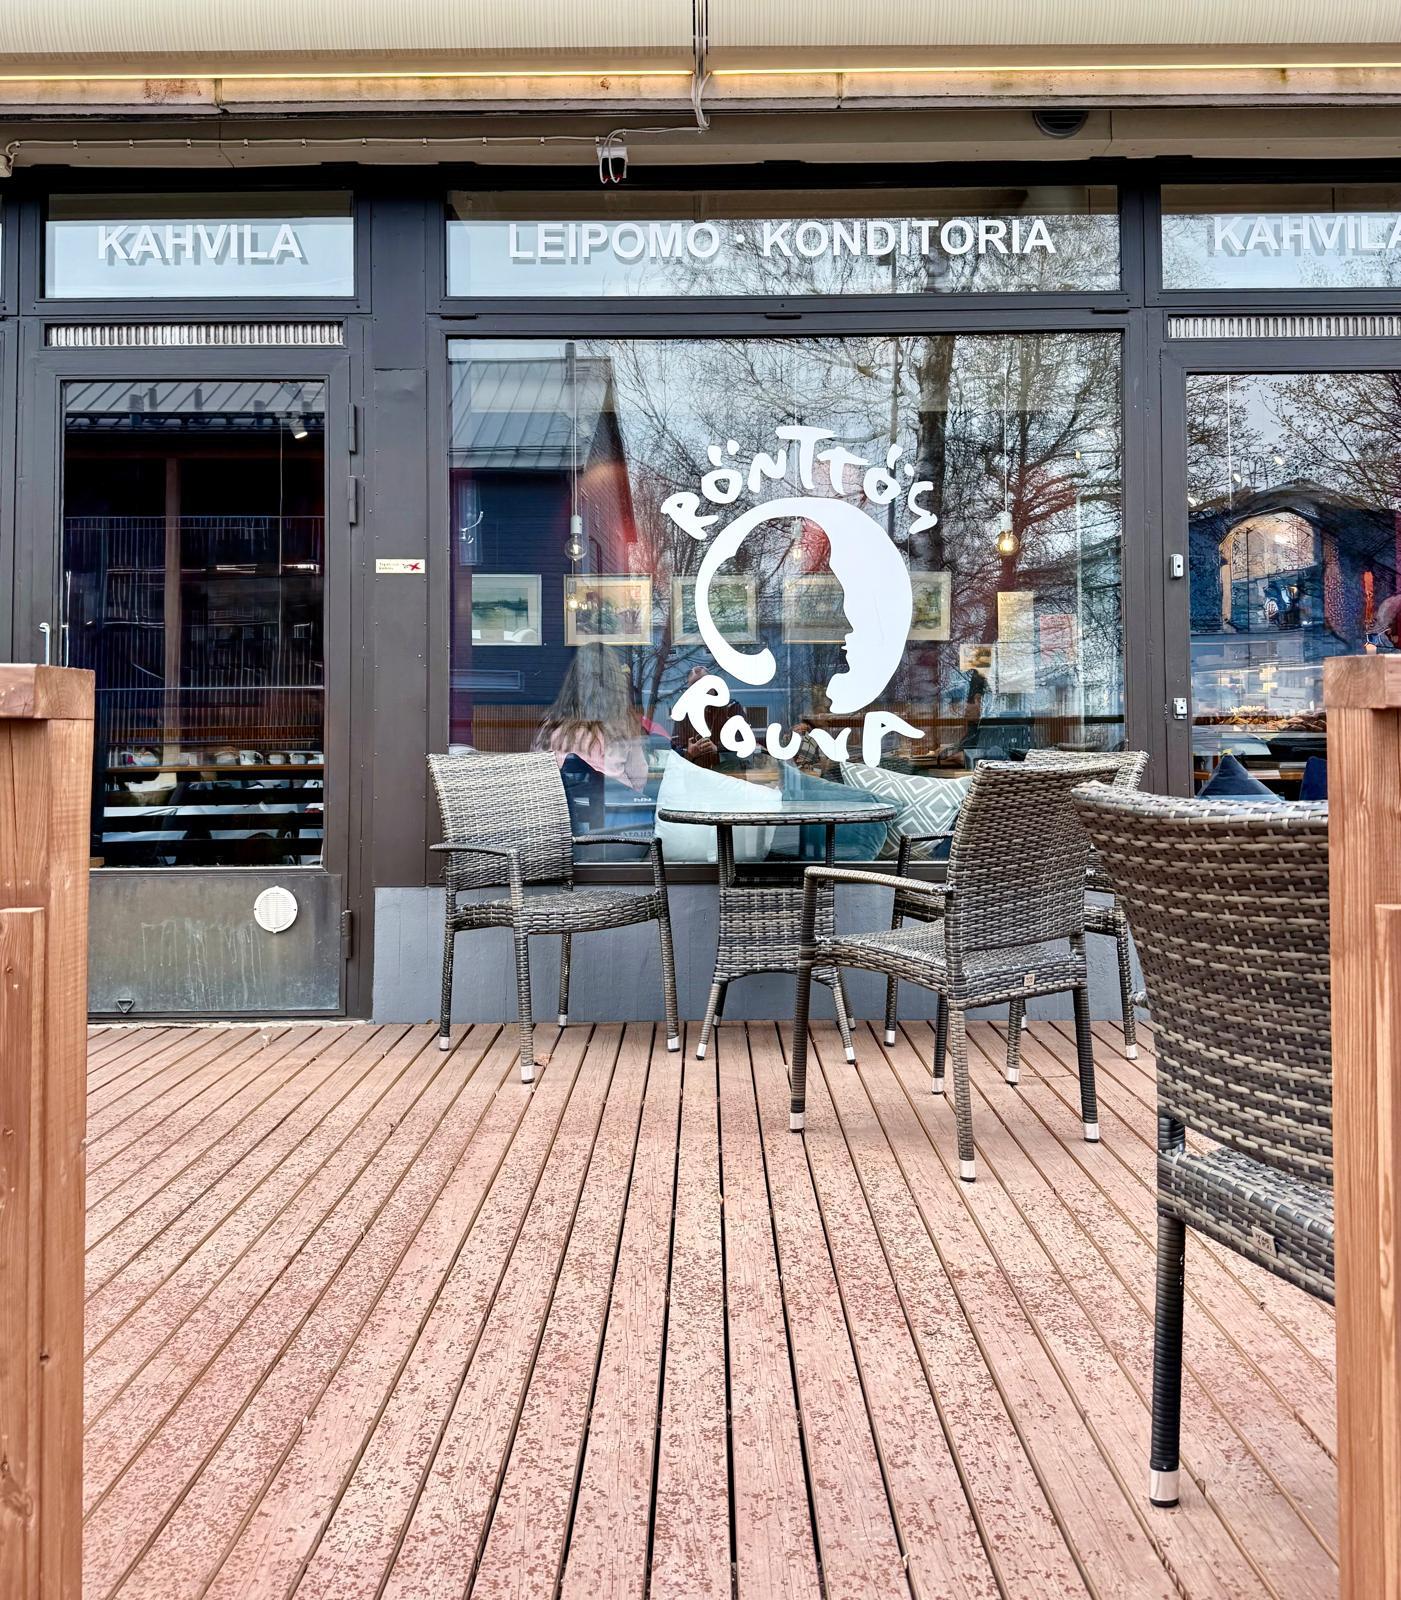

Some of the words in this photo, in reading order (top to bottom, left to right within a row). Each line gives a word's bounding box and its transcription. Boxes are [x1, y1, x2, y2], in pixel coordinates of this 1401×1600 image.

[98, 223, 303, 259] KAHVILA
[508, 222, 720, 258] LEIPOMO
[763, 219, 1056, 255] KONDITORIA
